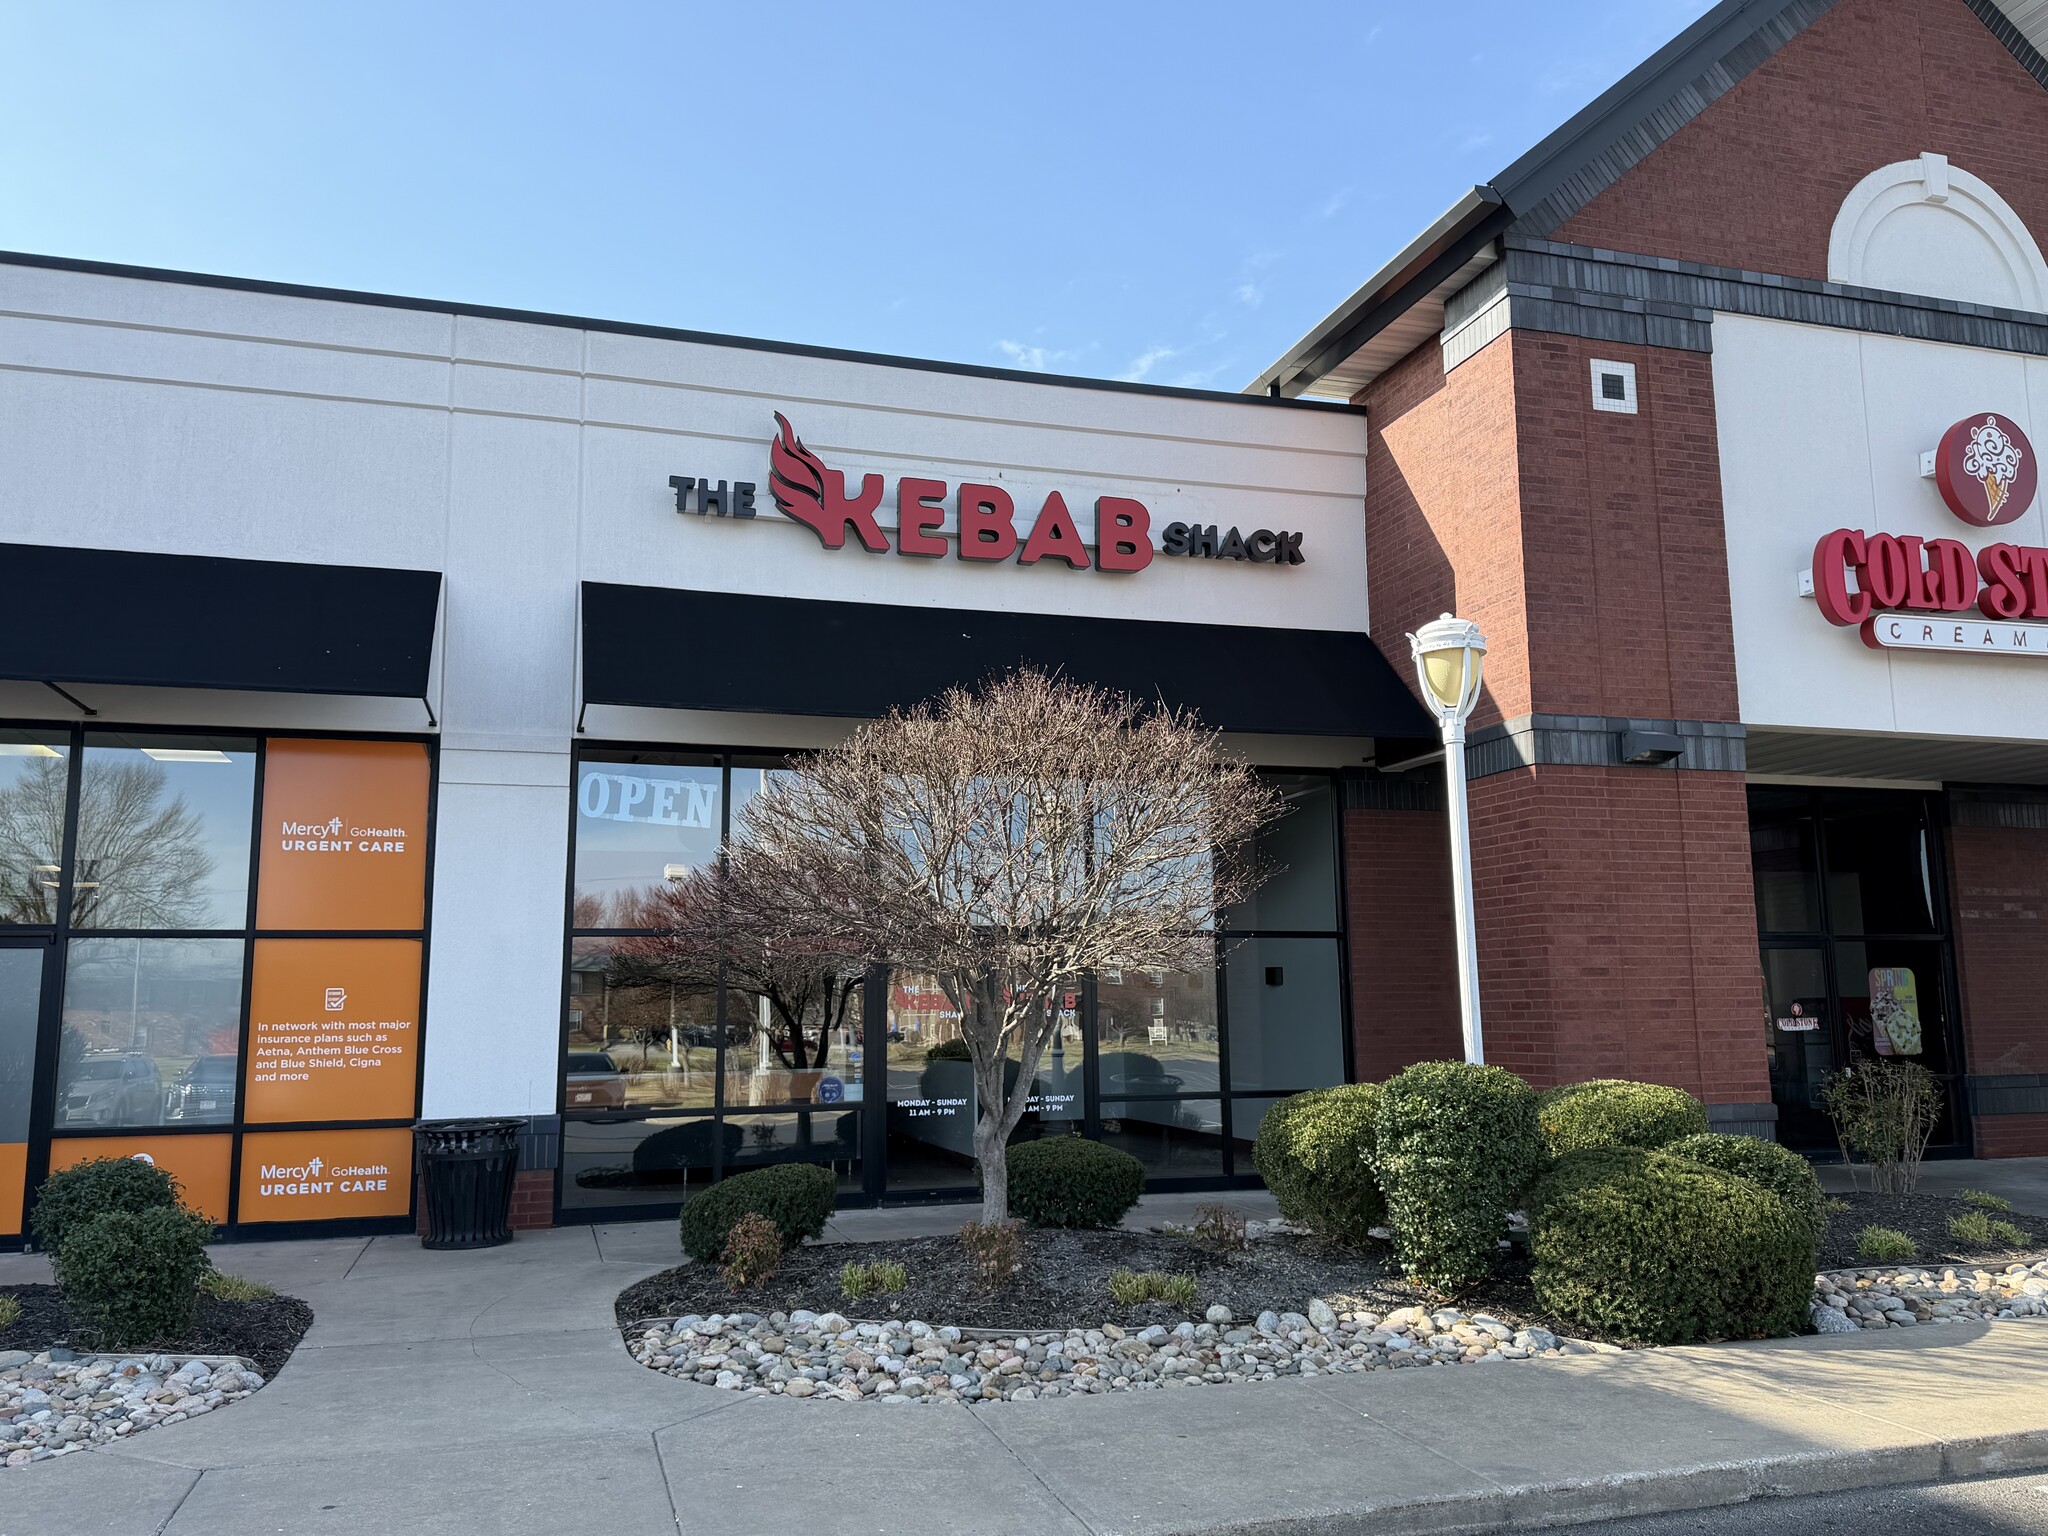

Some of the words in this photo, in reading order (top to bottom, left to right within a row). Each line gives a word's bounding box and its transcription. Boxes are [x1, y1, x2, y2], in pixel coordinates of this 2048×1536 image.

[669, 475, 757, 519] THE
[768, 411, 1155, 574] KEBAB
[1162, 521, 1306, 566] SHACK
[1812, 528, 1977, 627] COLD
[1890, 623, 2048, 647] CREAM
[578, 772, 717, 828] OPEN
[282, 821, 329, 838] Mercy
[282, 840, 352, 852] URGENT
[358, 841, 405, 852] CARE
[903, 985, 920, 994] THE
[1046, 1009, 1076, 1017] SACK
[258, 1022, 268, 1031] In
[272, 1022, 318, 1031] network
[321, 1021, 345, 1030] with
[348, 1021, 376, 1030] most
[379, 1020, 411, 1031] major
[257, 1035, 311, 1044] insurance
[314, 1034, 344, 1045] plans
[346, 1033, 373, 1042] such
[256, 1047, 293, 1057] Aetna,
[296, 1046, 341, 1056] Anthem
[344, 1046, 369, 1055] Blue
[371, 1045, 403, 1054] Cross
[255, 1060, 277, 1069] and
[280, 1060, 306, 1069] Blue
[308, 1058, 347, 1069] Shield,
[349, 1058, 382, 1069] Cigna
[255, 1073, 277, 1082] and
[279, 1073, 309, 1081] more
[897, 1099, 931, 1107] MONDAY
[936, 1098, 968, 1106] SUNDAY
[1045, 1094, 1075, 1102] SUNDAY
[909, 1109, 917, 1117] 11
[937, 1108, 942, 1116] 9
[1045, 1104, 1051, 1112] 9
[1052, 1104, 1064, 1112] PM
[260, 1165, 310, 1181] Mercy
[260, 1182, 334, 1196] URGENT
[339, 1180, 387, 1192] CARE
